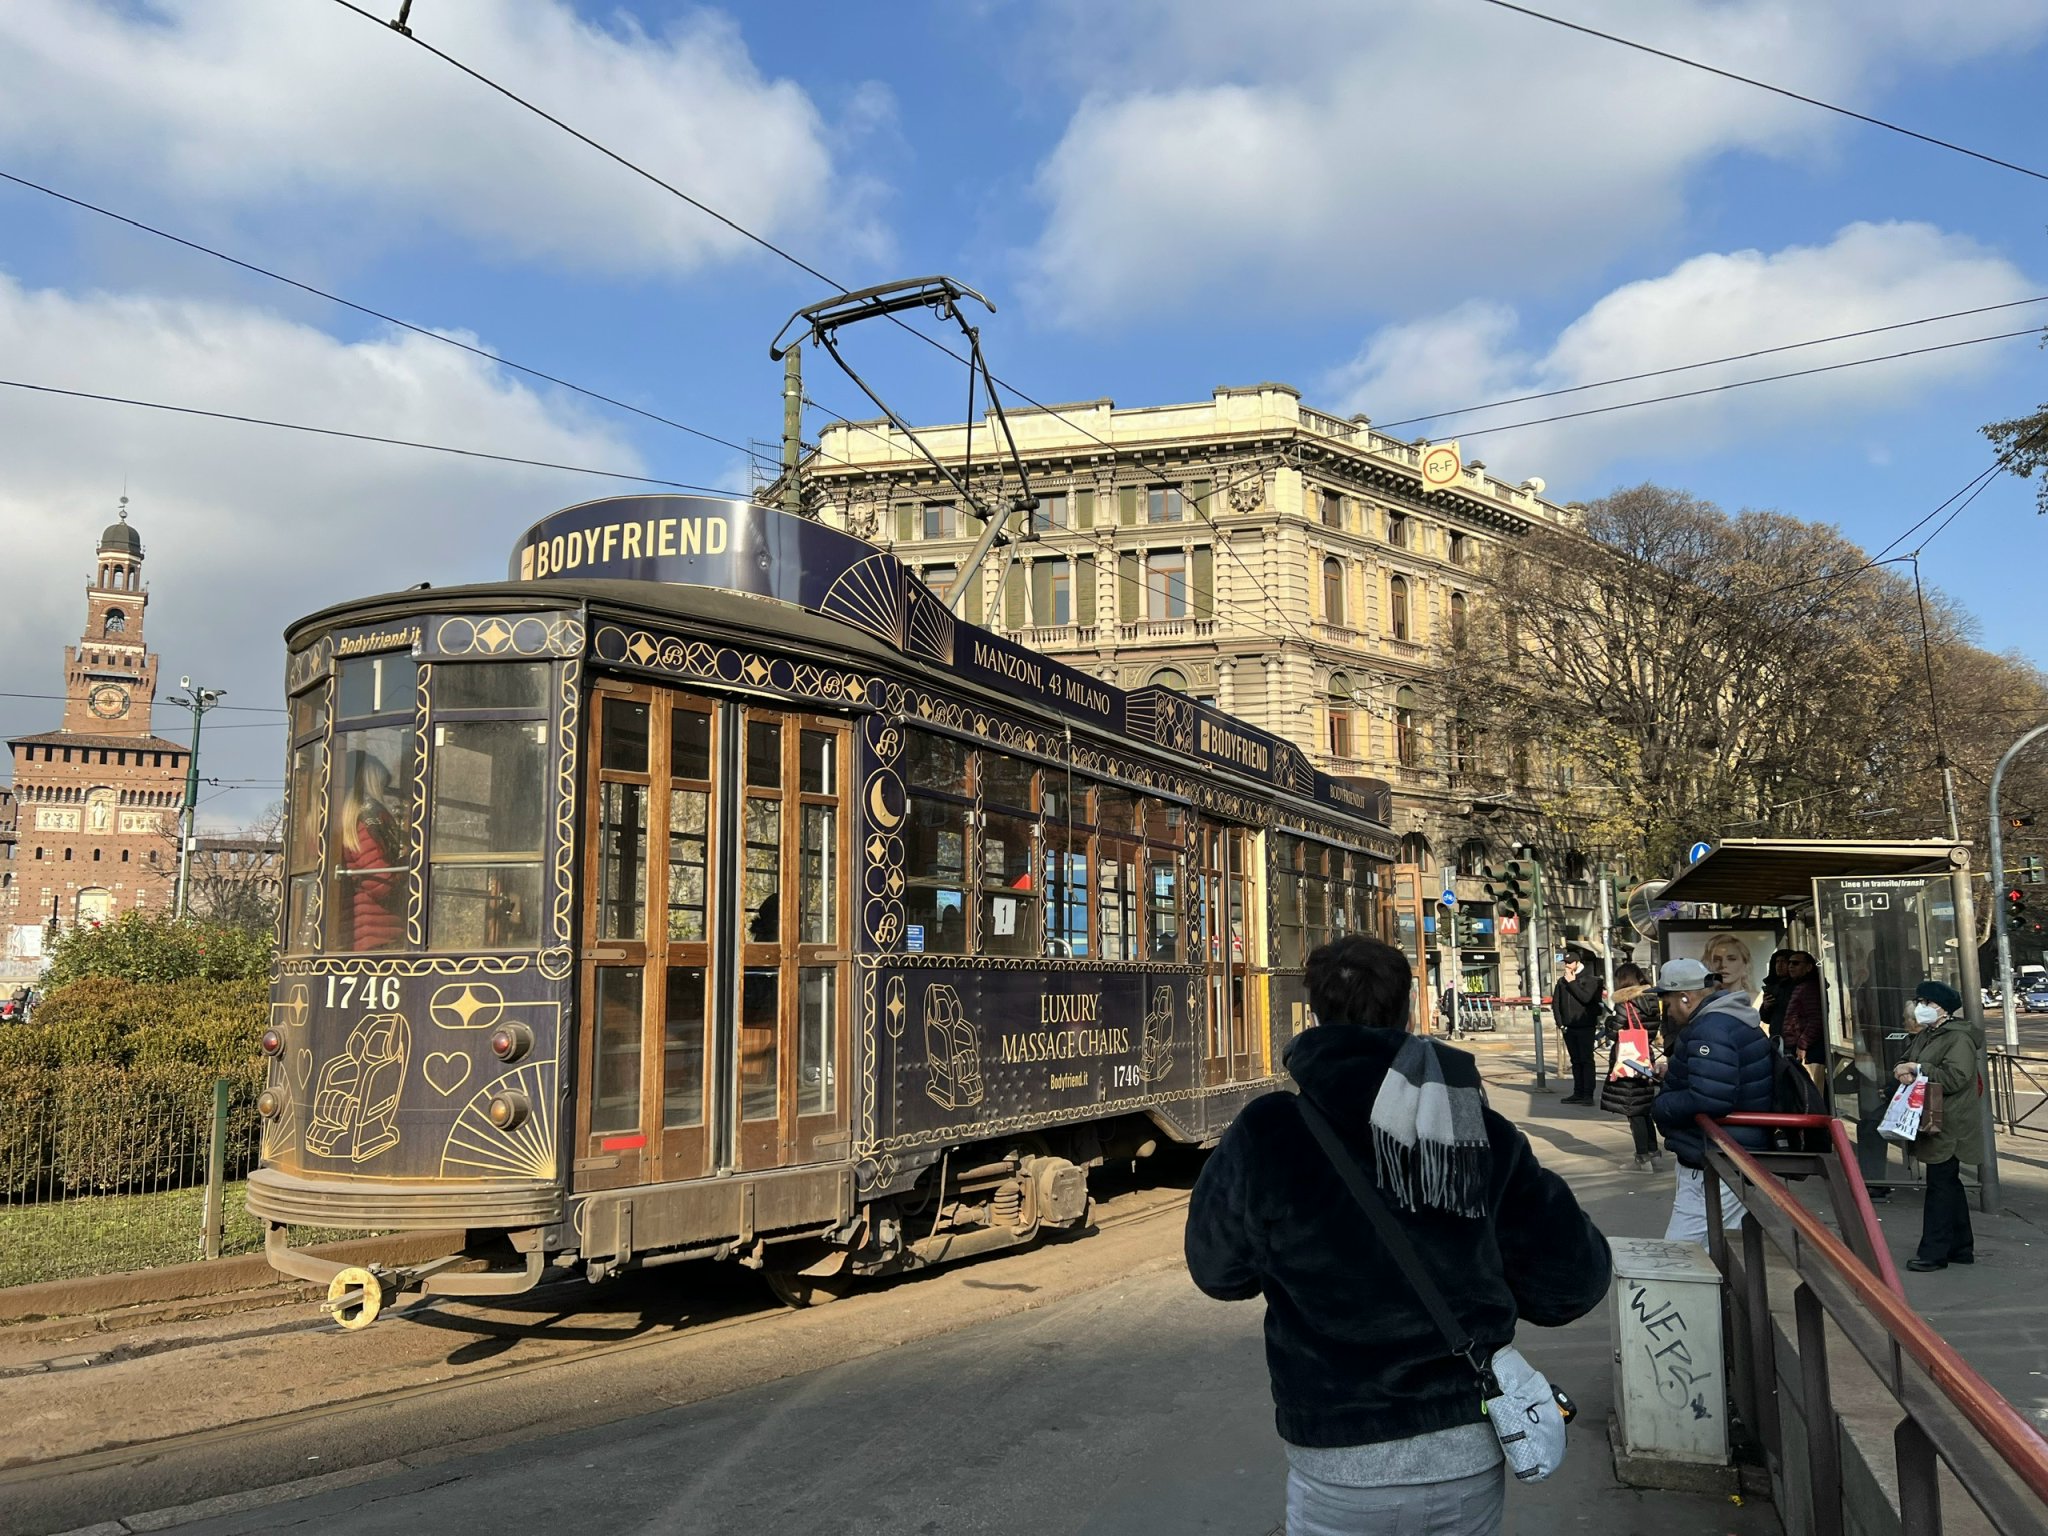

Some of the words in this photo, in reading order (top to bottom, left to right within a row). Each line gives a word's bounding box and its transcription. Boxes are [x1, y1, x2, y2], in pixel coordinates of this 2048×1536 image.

[1429, 460, 1453, 474] R-F
[536, 516, 728, 578] BODYFRIEND
[338, 626, 421, 655] Bodyfriend.it
[373, 660, 382, 710] 1
[974, 641, 1045, 694] MANZONI,
[1048, 673, 1061, 696] 43
[1065, 678, 1110, 715] MILANO
[1211, 725, 1268, 772] BODYFRIEND
[1851, 897, 1857, 905] 1
[1877, 897, 1883, 905] 4
[1501, 917, 1517, 930] M
[325, 975, 401, 1010] 1746
[1041, 993, 1099, 1023] LUXURY
[1001, 1031, 1076, 1064] MASSAGE
[1078, 1027, 1129, 1057] CHAIRS
[1050, 1071, 1089, 1092] Bodyfriend.it
[1113, 1065, 1140, 1088] 1746
